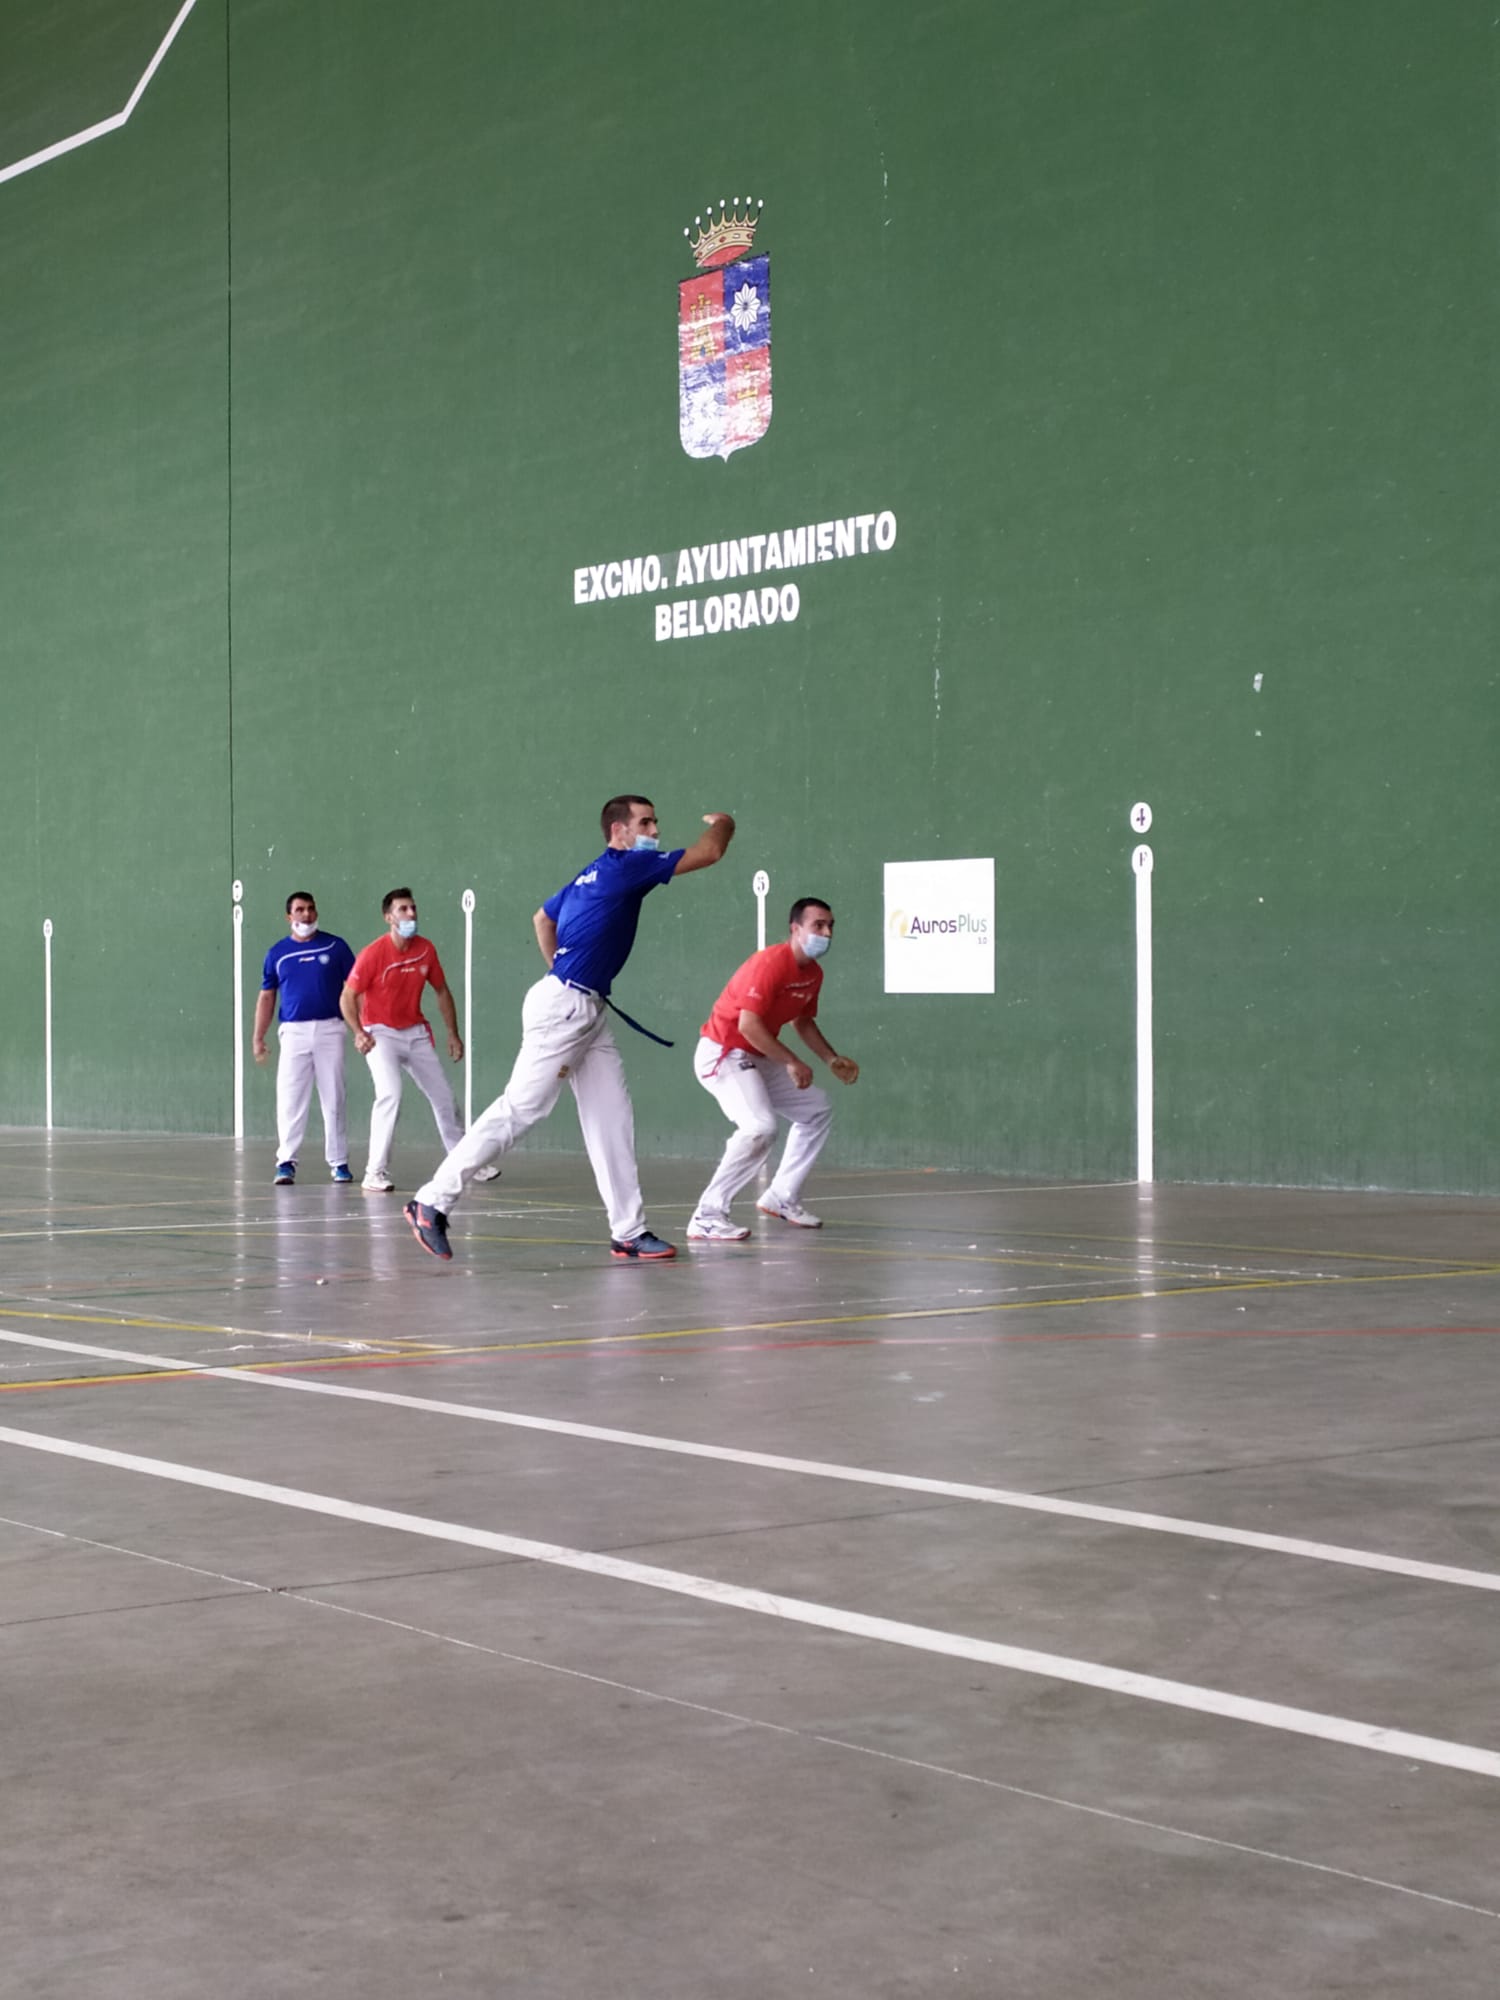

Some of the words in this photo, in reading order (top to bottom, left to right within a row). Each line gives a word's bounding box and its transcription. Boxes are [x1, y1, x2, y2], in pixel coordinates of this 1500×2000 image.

[574, 554, 668, 604] EXCMO.
[675, 510, 897, 587] AYUNTAMIENTO
[655, 583, 801, 642] BELORADO
[910, 913, 988, 934] AurosPlus
